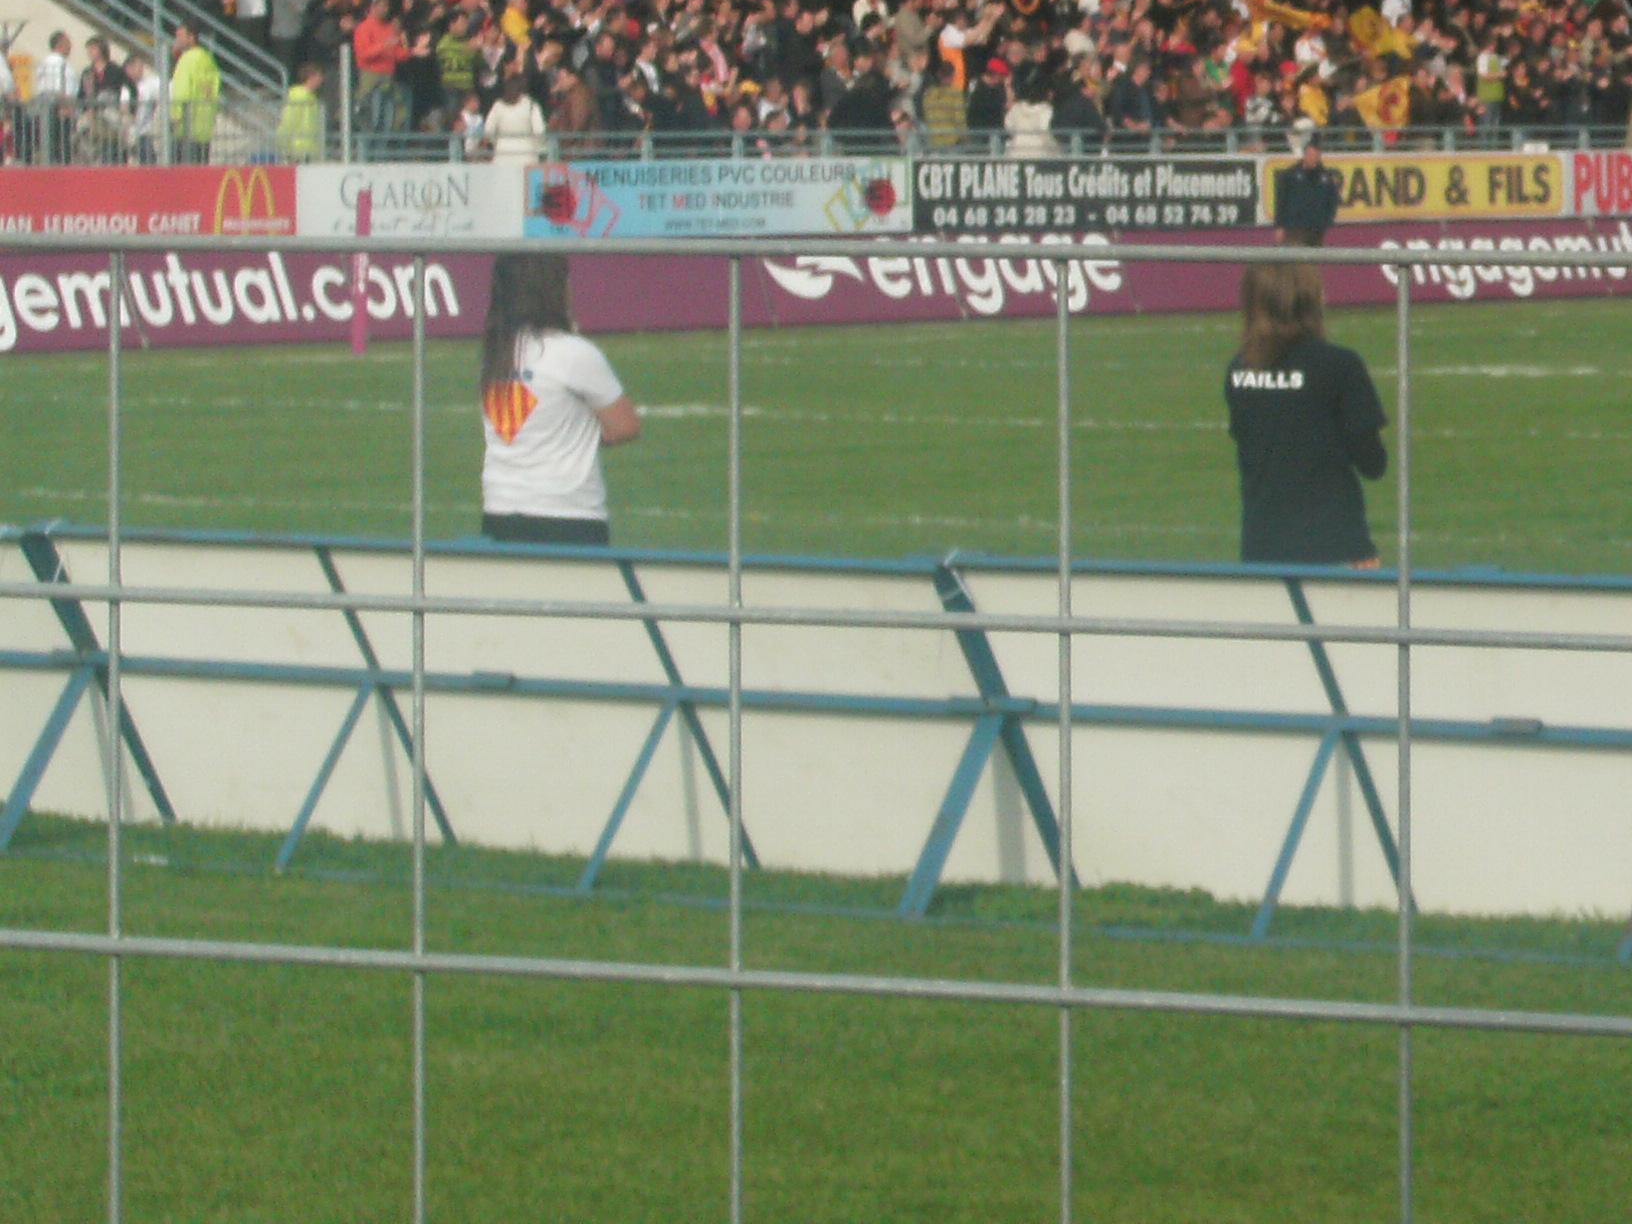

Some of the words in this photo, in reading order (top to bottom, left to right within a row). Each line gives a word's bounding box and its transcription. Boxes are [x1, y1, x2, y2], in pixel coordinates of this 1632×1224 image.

[585, 165, 711, 188] MENUISERIES
[718, 163, 756, 184] PVC
[918, 163, 954, 198] CBT
[959, 163, 1019, 198] PLANE
[1445, 165, 1470, 205] &
[1488, 163, 1551, 204] FILS
[712, 190, 795, 210] INDUSTRIE
[868, 233, 1123, 315] engage
[1231, 370, 1304, 389] VAILLS
